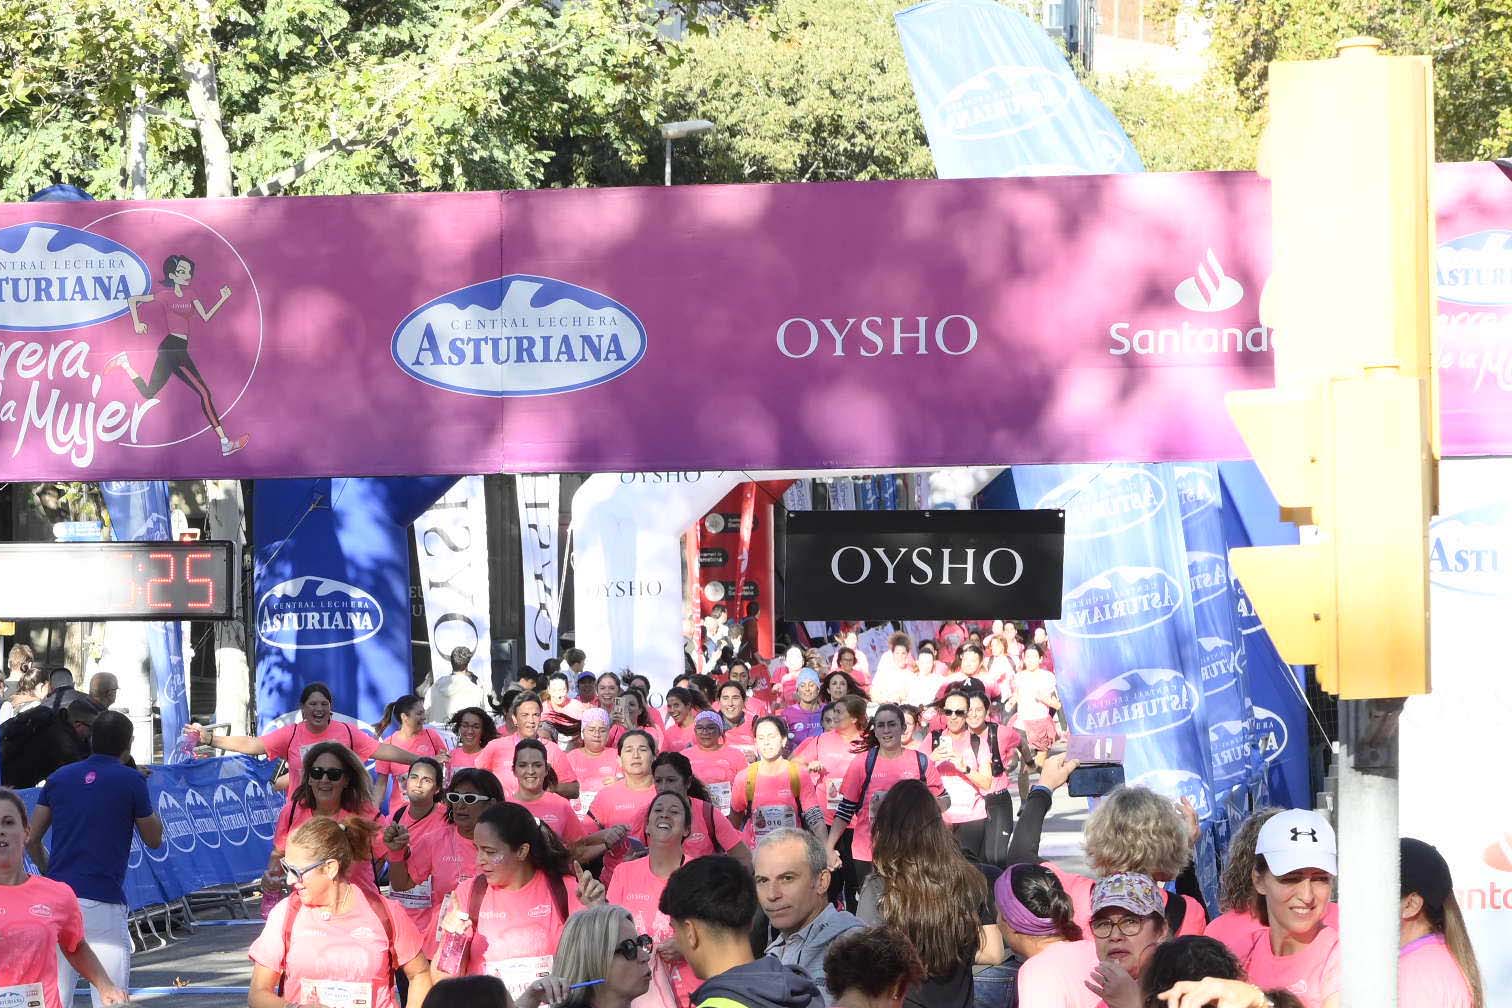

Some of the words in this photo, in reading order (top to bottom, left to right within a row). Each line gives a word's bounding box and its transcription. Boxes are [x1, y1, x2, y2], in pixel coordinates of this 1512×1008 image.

[52, 258, 126, 270] LECHERA
[450, 318, 529, 331] CENTRAL
[537, 316, 618, 328] LECHERA
[775, 314, 979, 360] OYSHO
[1109, 318, 1281, 356] Santand
[411, 322, 627, 366] ASTURIANA
[11, 374, 161, 468] Mujer
[830, 545, 1025, 588] OYSHO
[260, 604, 375, 634] ASTURIANA
[272, 600, 317, 611] CENTRAL
[320, 598, 370, 609] LECHERA
